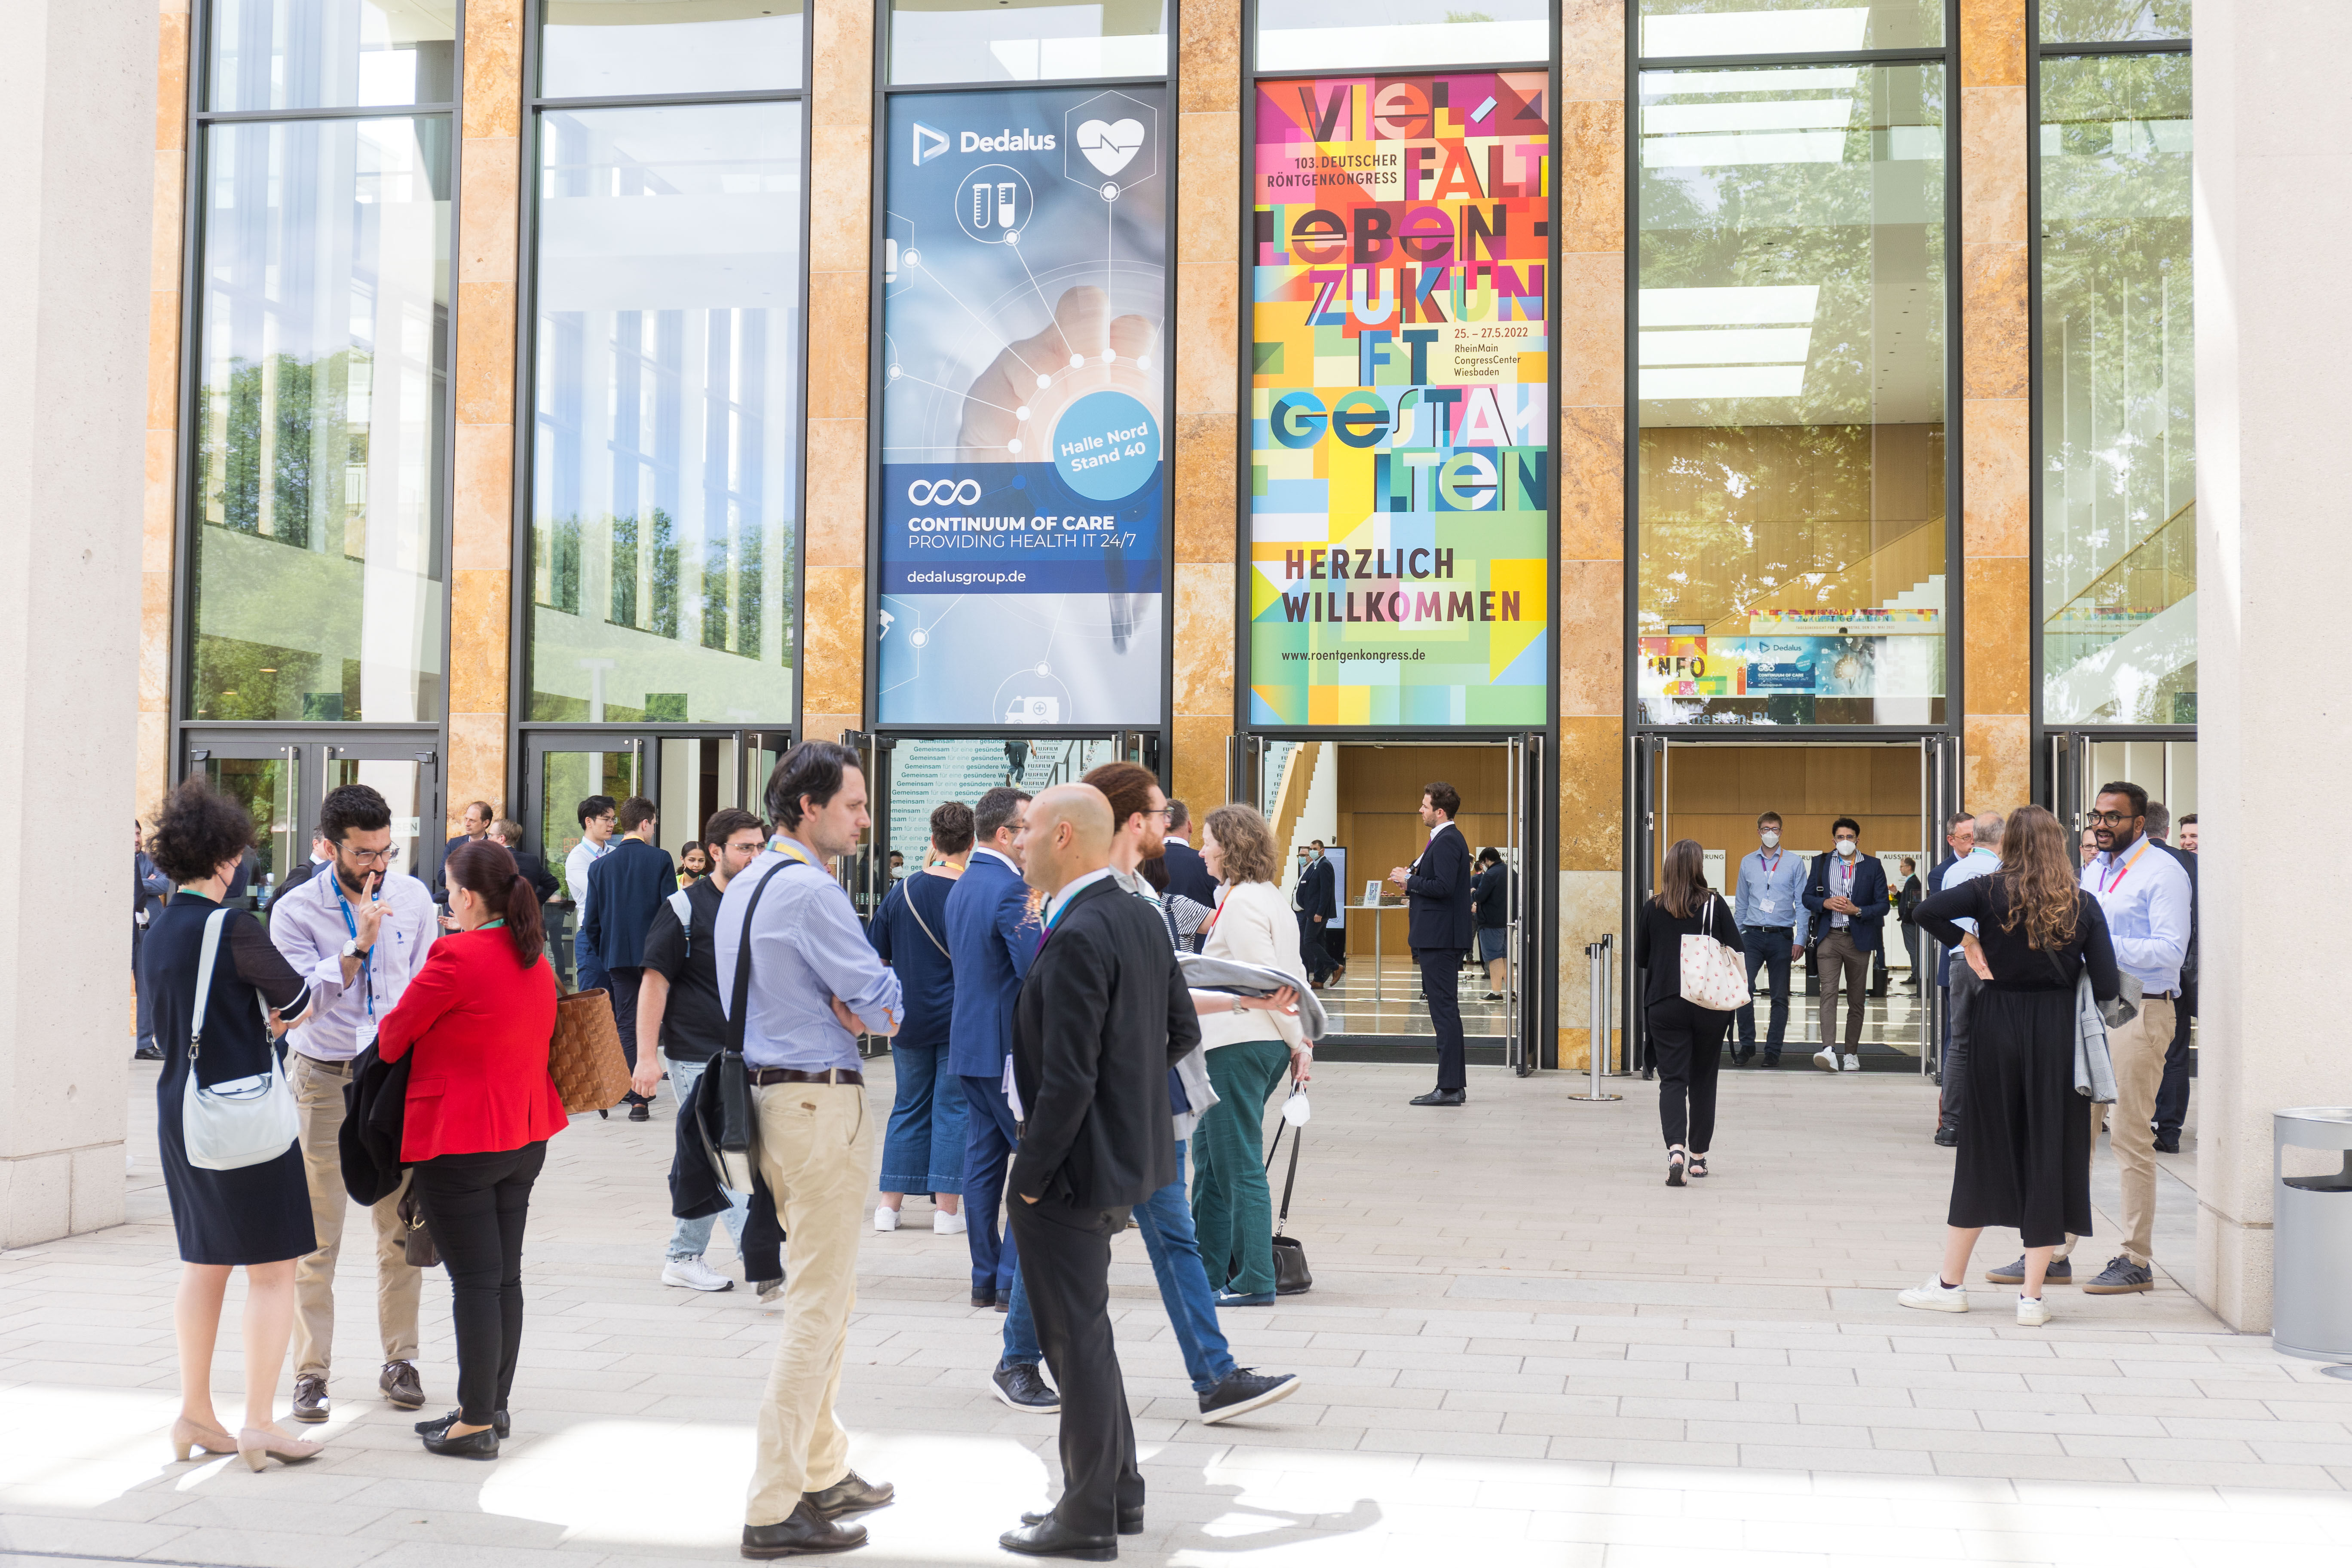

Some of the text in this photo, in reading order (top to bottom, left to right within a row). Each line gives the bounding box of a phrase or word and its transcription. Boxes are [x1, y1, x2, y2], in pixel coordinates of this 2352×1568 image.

[960, 128, 1056, 153] Dedalus
[1295, 154, 1396, 169] 103. DEUTSCHER
[1268, 172, 1397, 187] RÖNTGENKONGRESS
[1455, 329, 1469, 338] 25.
[1481, 327, 1528, 338] 27.5.2022
[1455, 344, 1498, 353] RheinMain
[1455, 355, 1521, 367] CongressCenter
[1454, 368, 1499, 377] Wiesbaden
[1061, 422, 1148, 456] Halle Nord
[1071, 442, 1146, 472] Stand 40
[908, 516, 1114, 532] CONTINUUM OF CARE
[909, 532, 1136, 549] PROVIDING HEALTH IT 24/7
[1286, 548, 1453, 579] HERZLICH
[907, 570, 1026, 585] dedalusgroup.de
[1282, 591, 1520, 622] WILLKOMMEN
[1281, 648, 1425, 663] www.roentgenkongress.de
[1649, 657, 1705, 678] INFO
